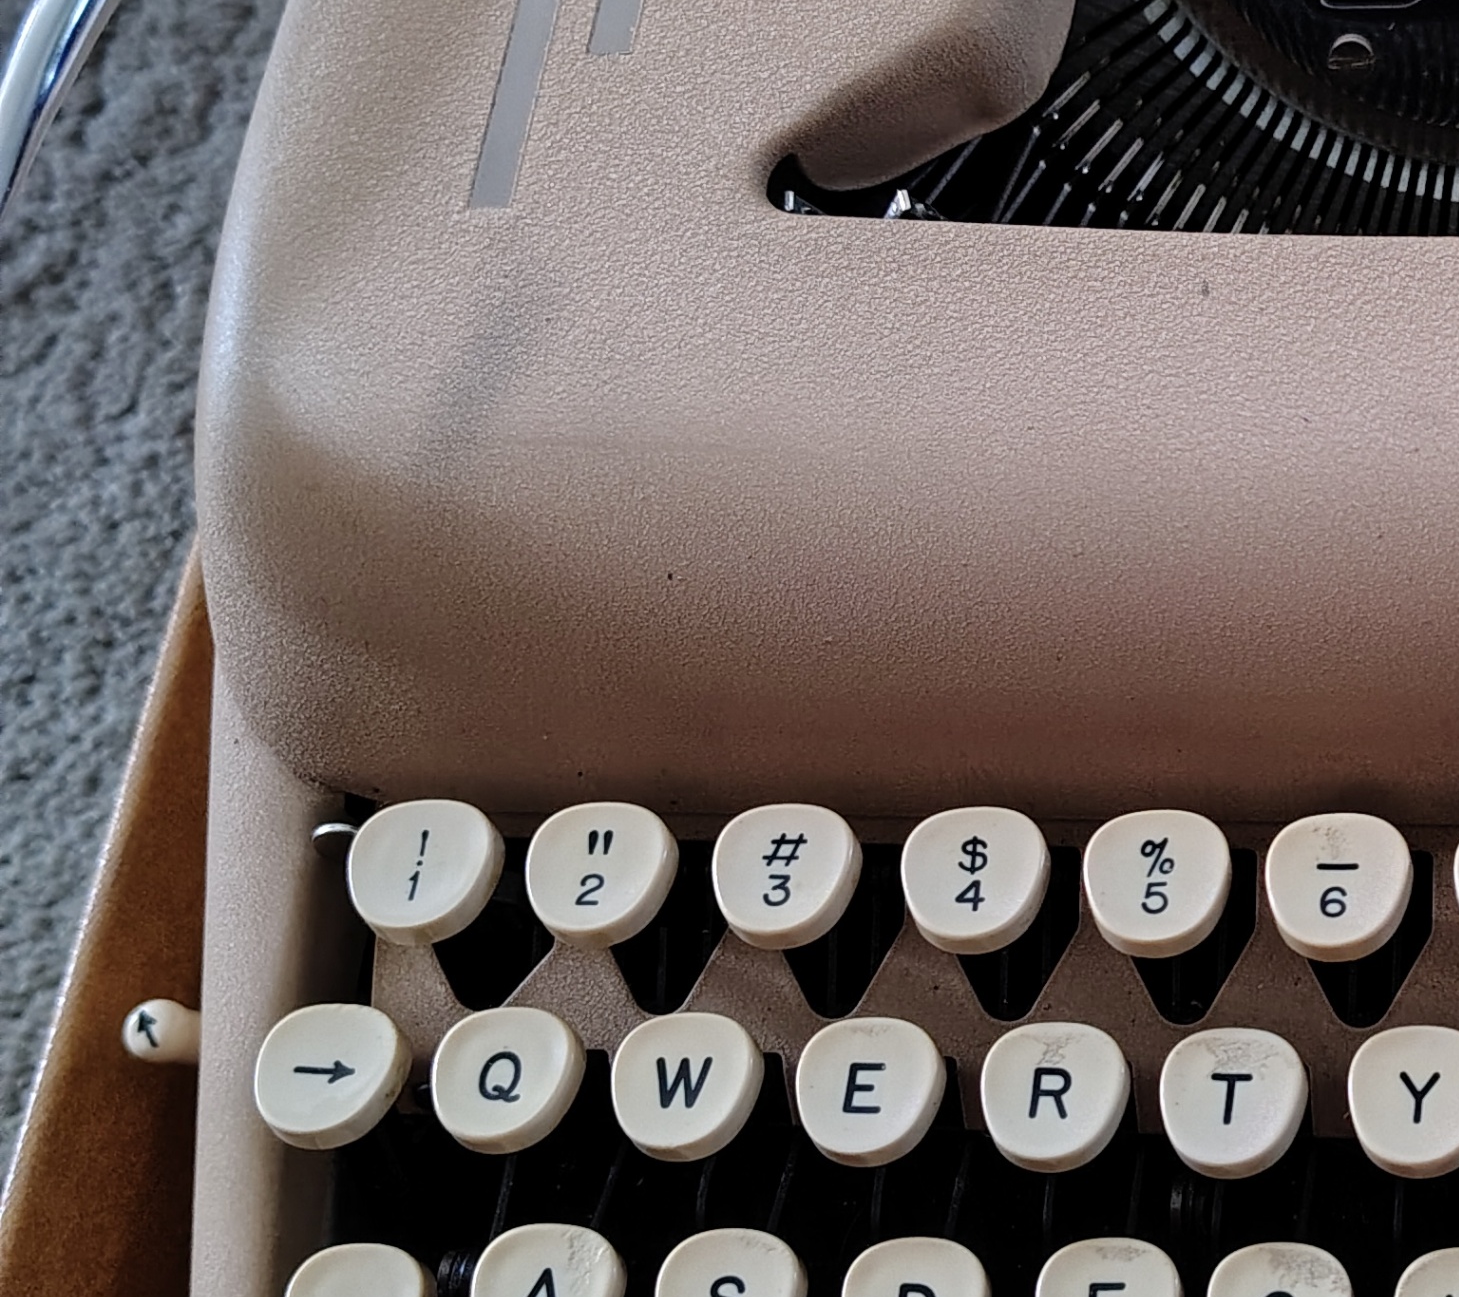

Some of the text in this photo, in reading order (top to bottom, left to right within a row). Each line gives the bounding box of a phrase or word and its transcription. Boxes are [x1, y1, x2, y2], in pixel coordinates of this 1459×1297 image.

[761, 831, 809, 868] #
[957, 834, 989, 876] $
[1139, 836, 1176, 879] %
[407, 869, 421, 902] 1
[573, 872, 606, 907] 2
[761, 873, 792, 908] 3
[953, 878, 986, 913] 4
[1140, 880, 1170, 916] 5
[1318, 885, 1348, 919] 6
[477, 1050, 523, 1104] Q
[654, 1055, 714, 1110] W
[841, 1061, 887, 1115] E
[1027, 1065, 1073, 1121] R
[1398, 1070, 1442, 1125] Y
[1209, 1071, 1254, 1126] T
